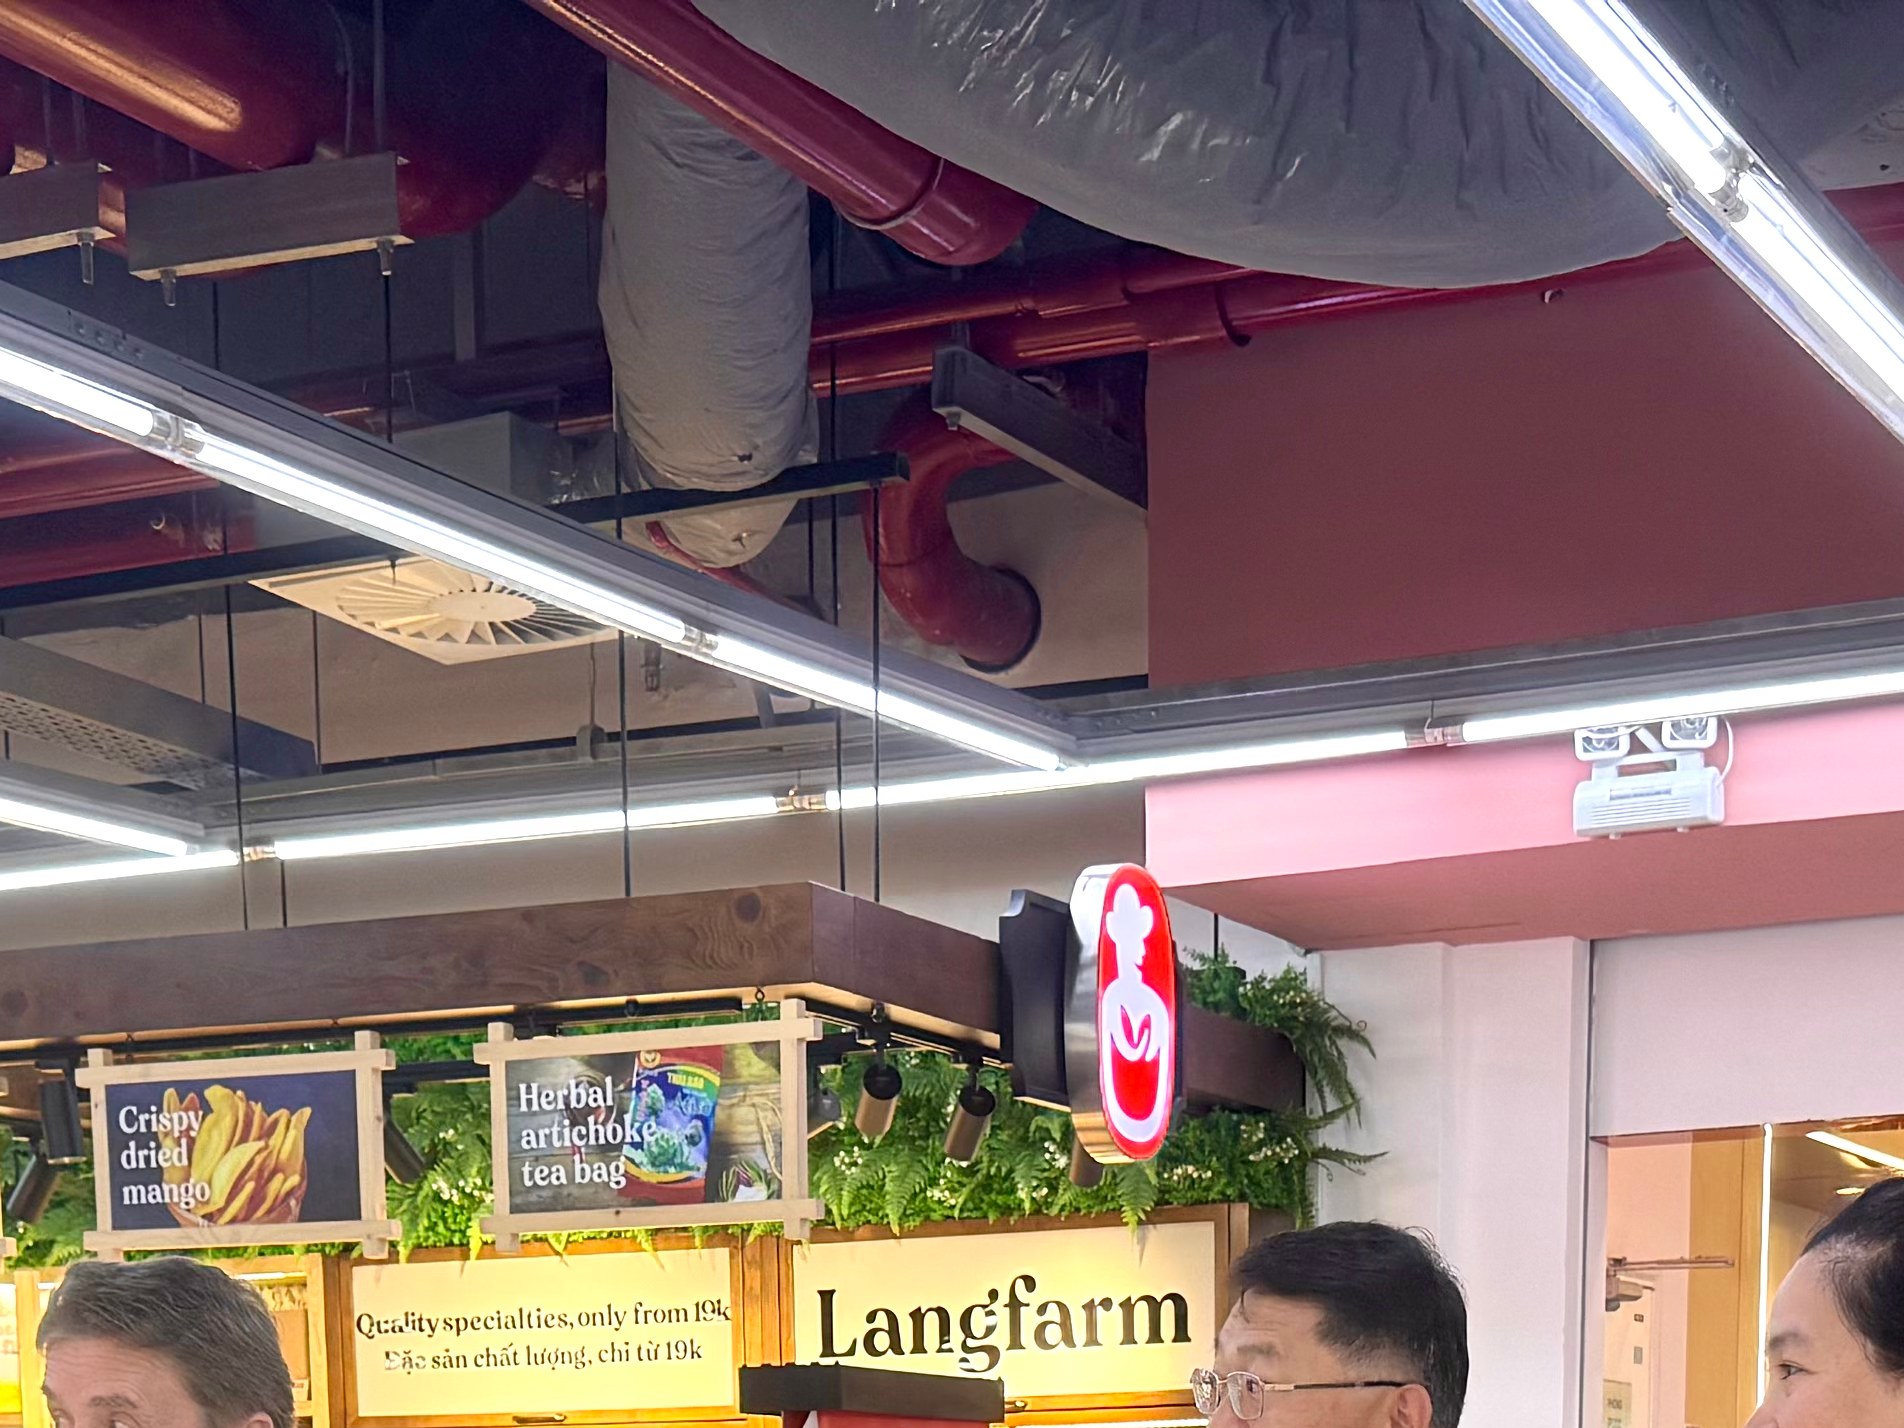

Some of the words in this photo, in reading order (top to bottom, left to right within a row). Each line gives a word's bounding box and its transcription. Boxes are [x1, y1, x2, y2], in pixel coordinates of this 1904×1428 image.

[518, 1076, 614, 1112] Herbal
[118, 1105, 204, 1138] Crispy
[521, 1114, 657, 1150] artichoke
[120, 1138, 189, 1170] dried
[521, 1161, 567, 1187] tea
[573, 1154, 627, 1189] bag
[122, 1179, 211, 1210] mango
[356, 1311, 438, 1339] Quality
[442, 1308, 574, 1338] specialties,
[578, 1304, 628, 1331] only
[634, 1301, 690, 1326] from
[693, 1298, 731, 1323] 19k
[817, 1274, 1192, 1373] Langfarm
[474, 1342, 520, 1368] chất
[637, 1340, 660, 1361] từ
[666, 1338, 703, 1360] 19k
